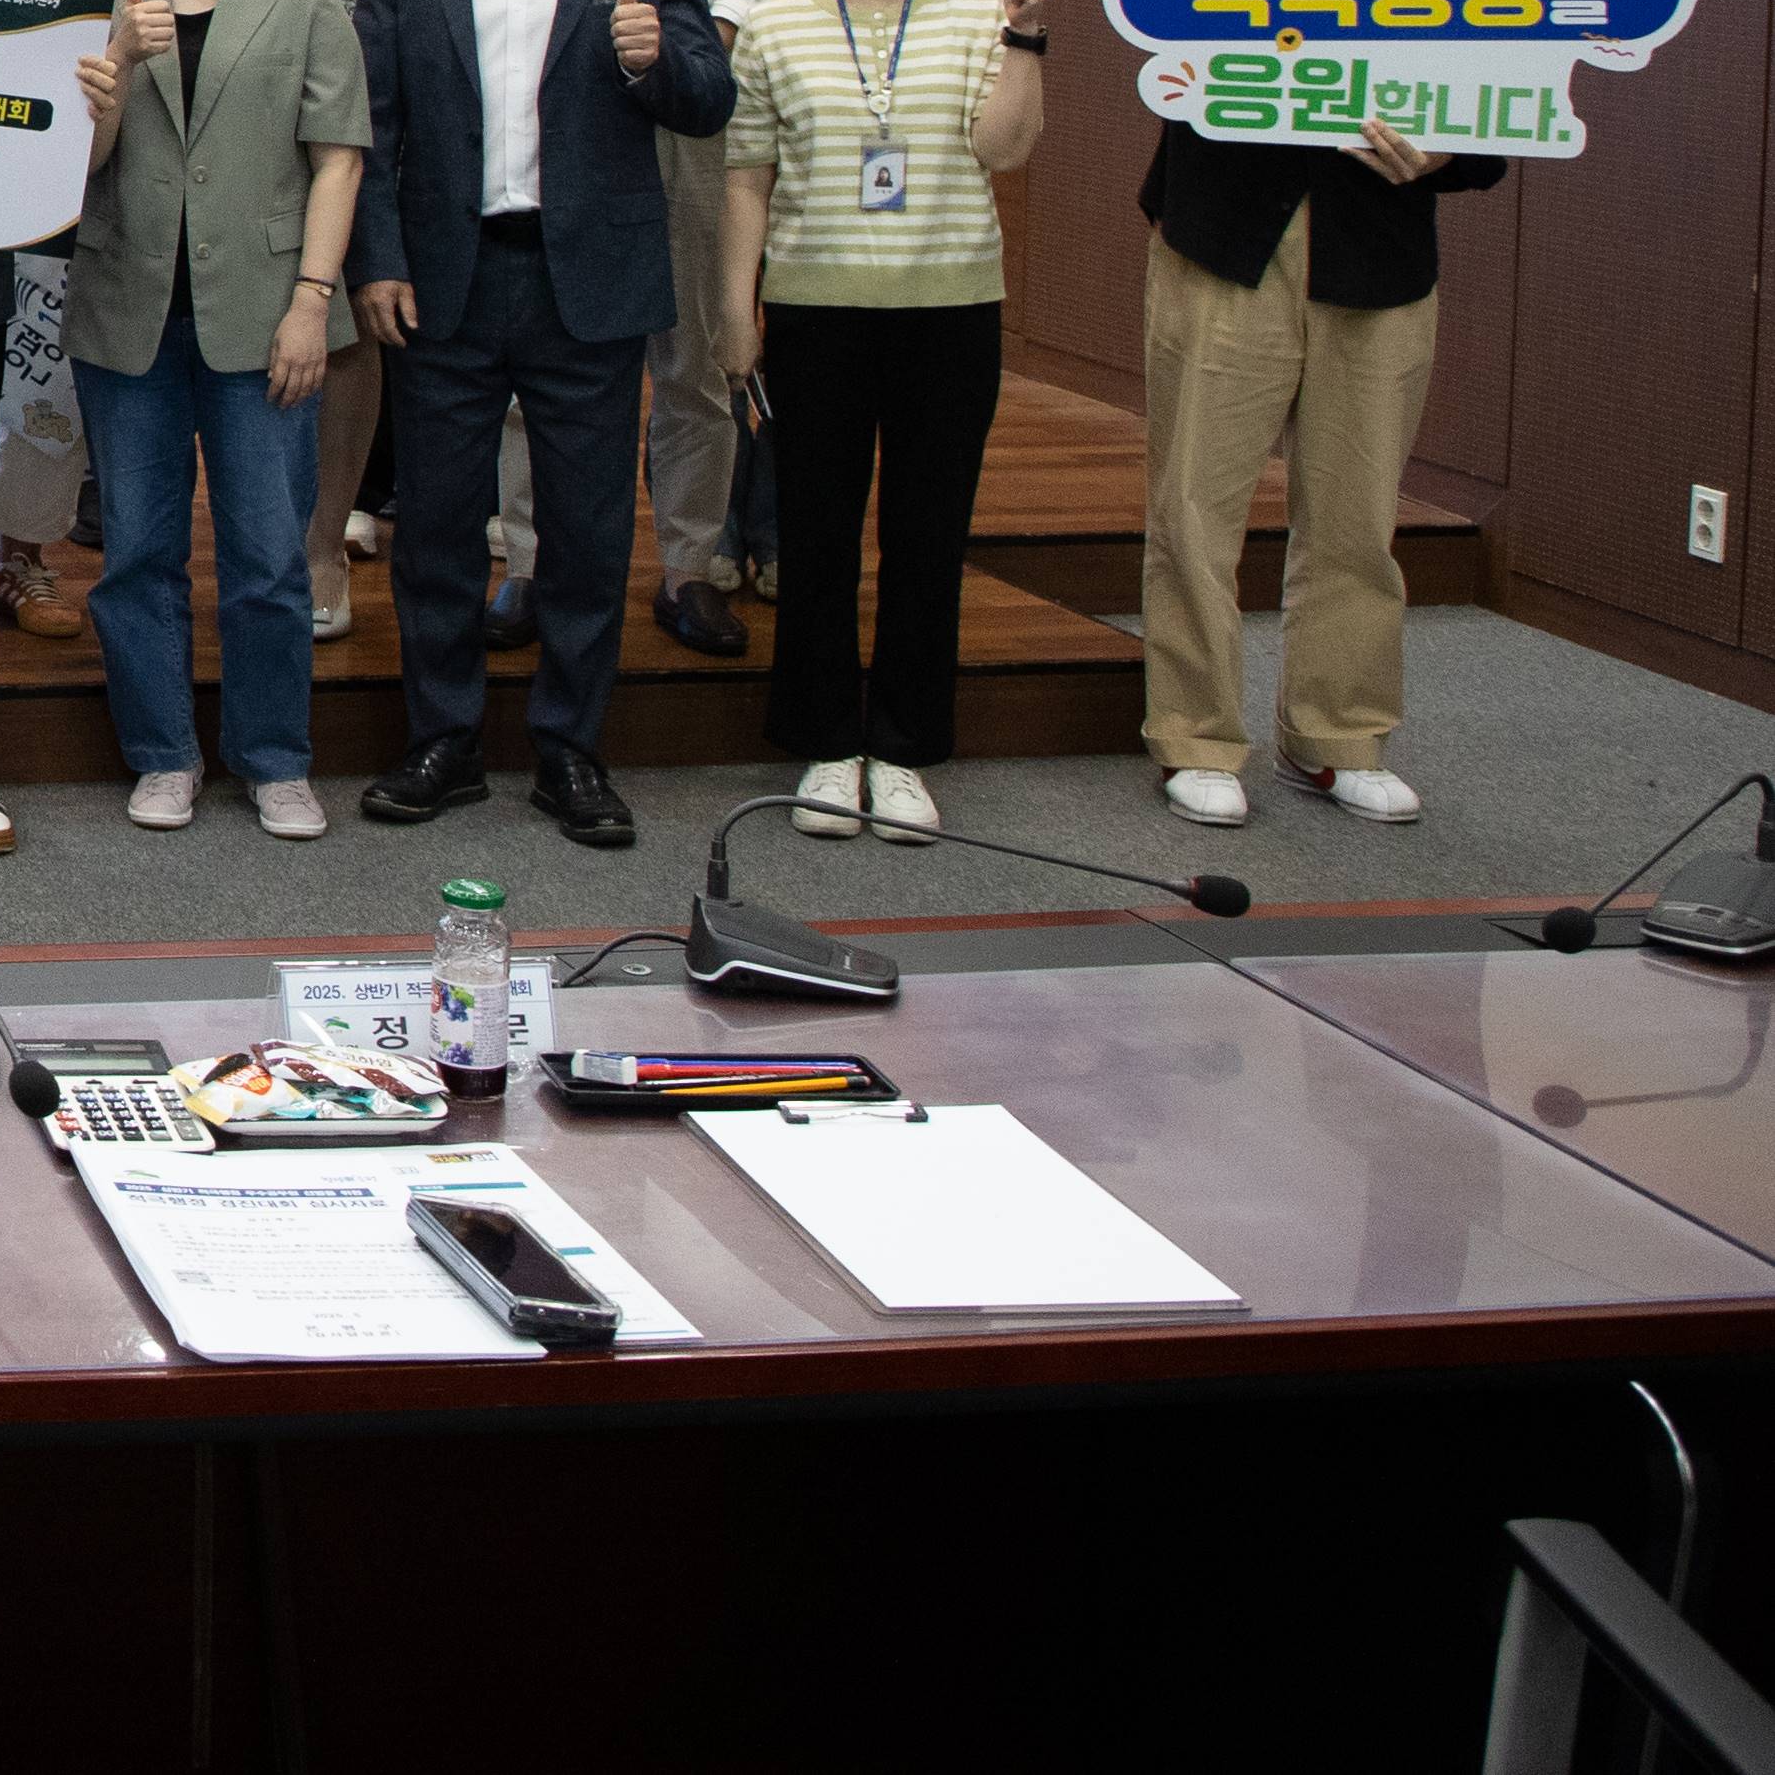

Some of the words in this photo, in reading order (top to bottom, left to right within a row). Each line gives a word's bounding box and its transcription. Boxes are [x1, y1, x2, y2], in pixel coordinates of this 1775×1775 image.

[1203, 52, 1573, 143] 응원합니다.
[302, 985, 347, 1001] 2025.
[354, 982, 401, 1001] 상반기
